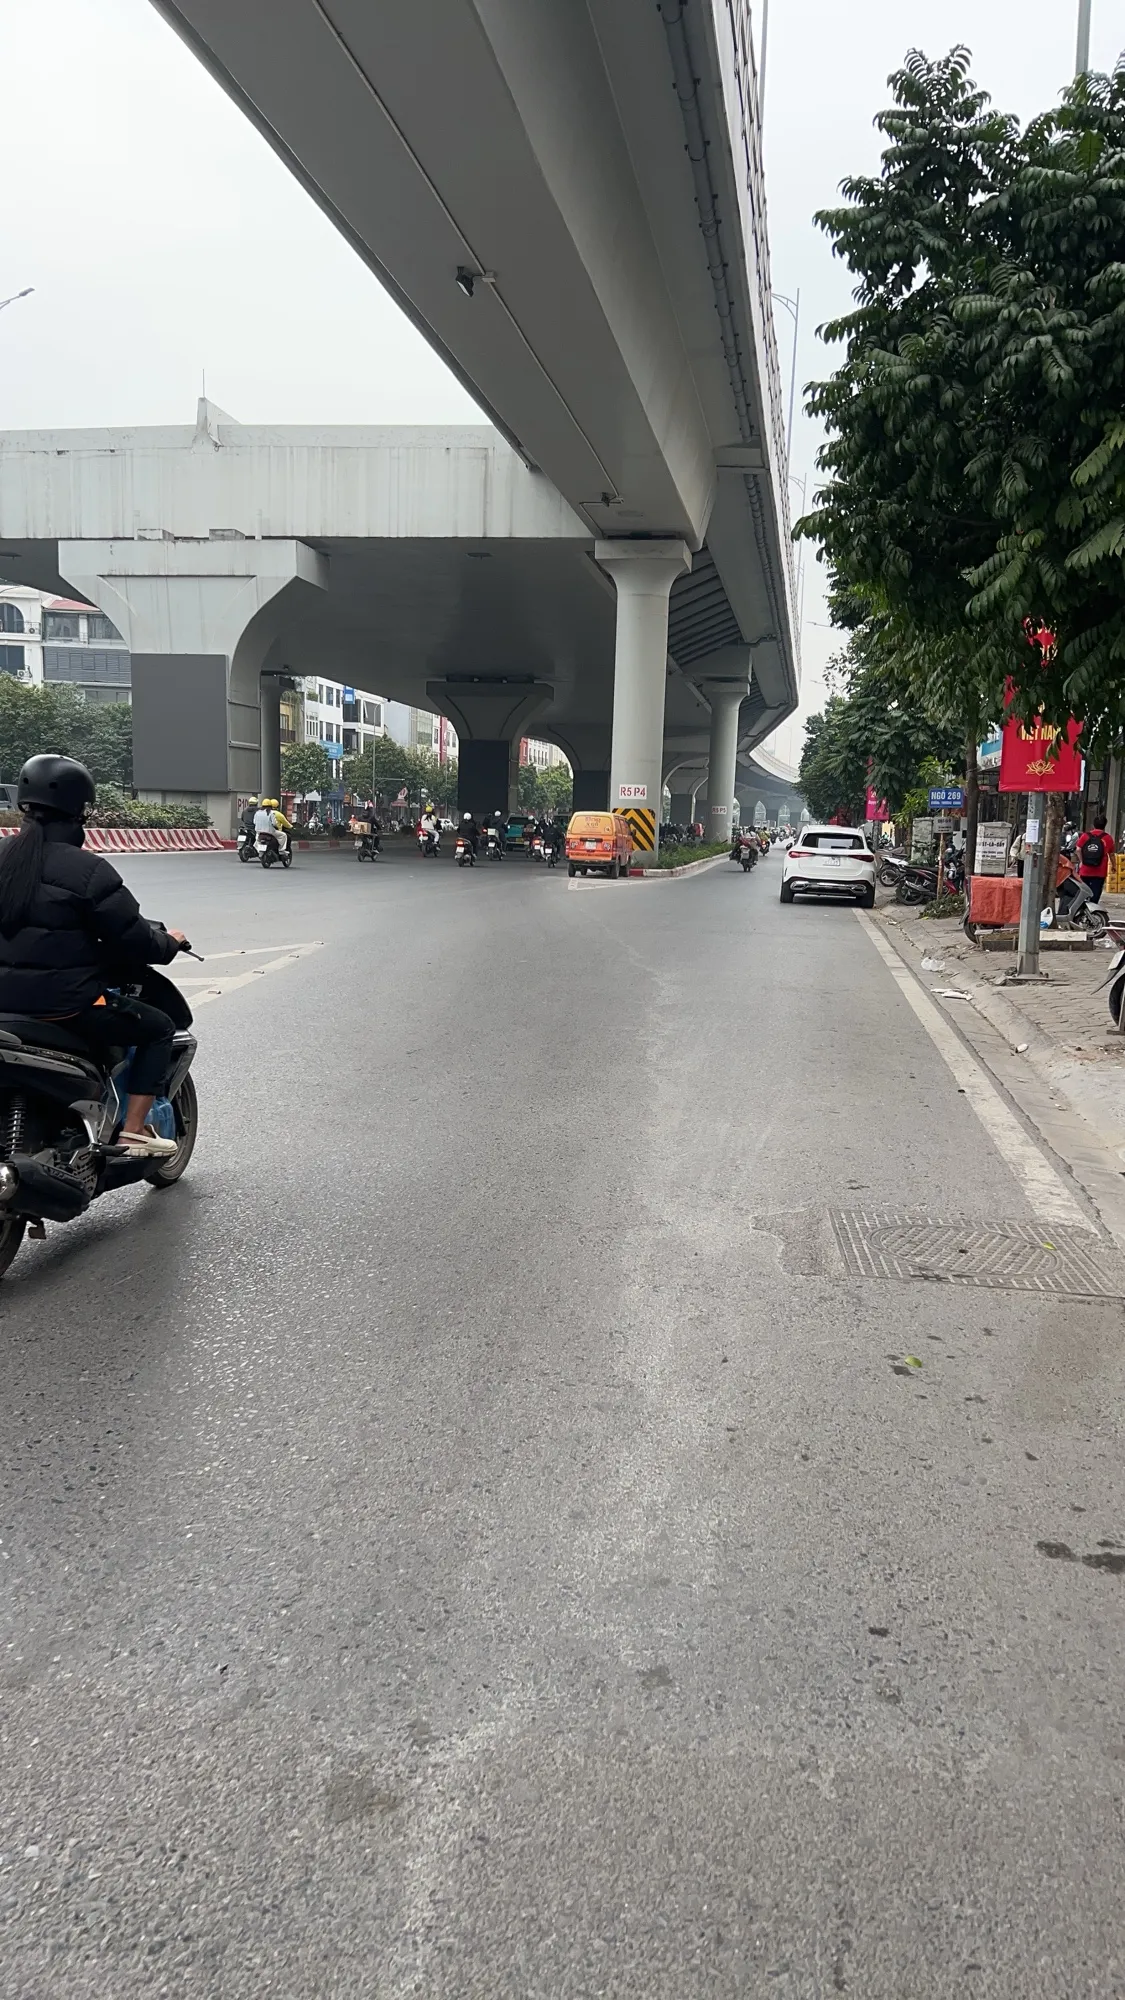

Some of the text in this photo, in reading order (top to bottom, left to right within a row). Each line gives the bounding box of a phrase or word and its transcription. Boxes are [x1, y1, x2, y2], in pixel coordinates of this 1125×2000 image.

[620, 786, 646, 797] R5 P4
[931, 790, 961, 800] NGÕ 269
